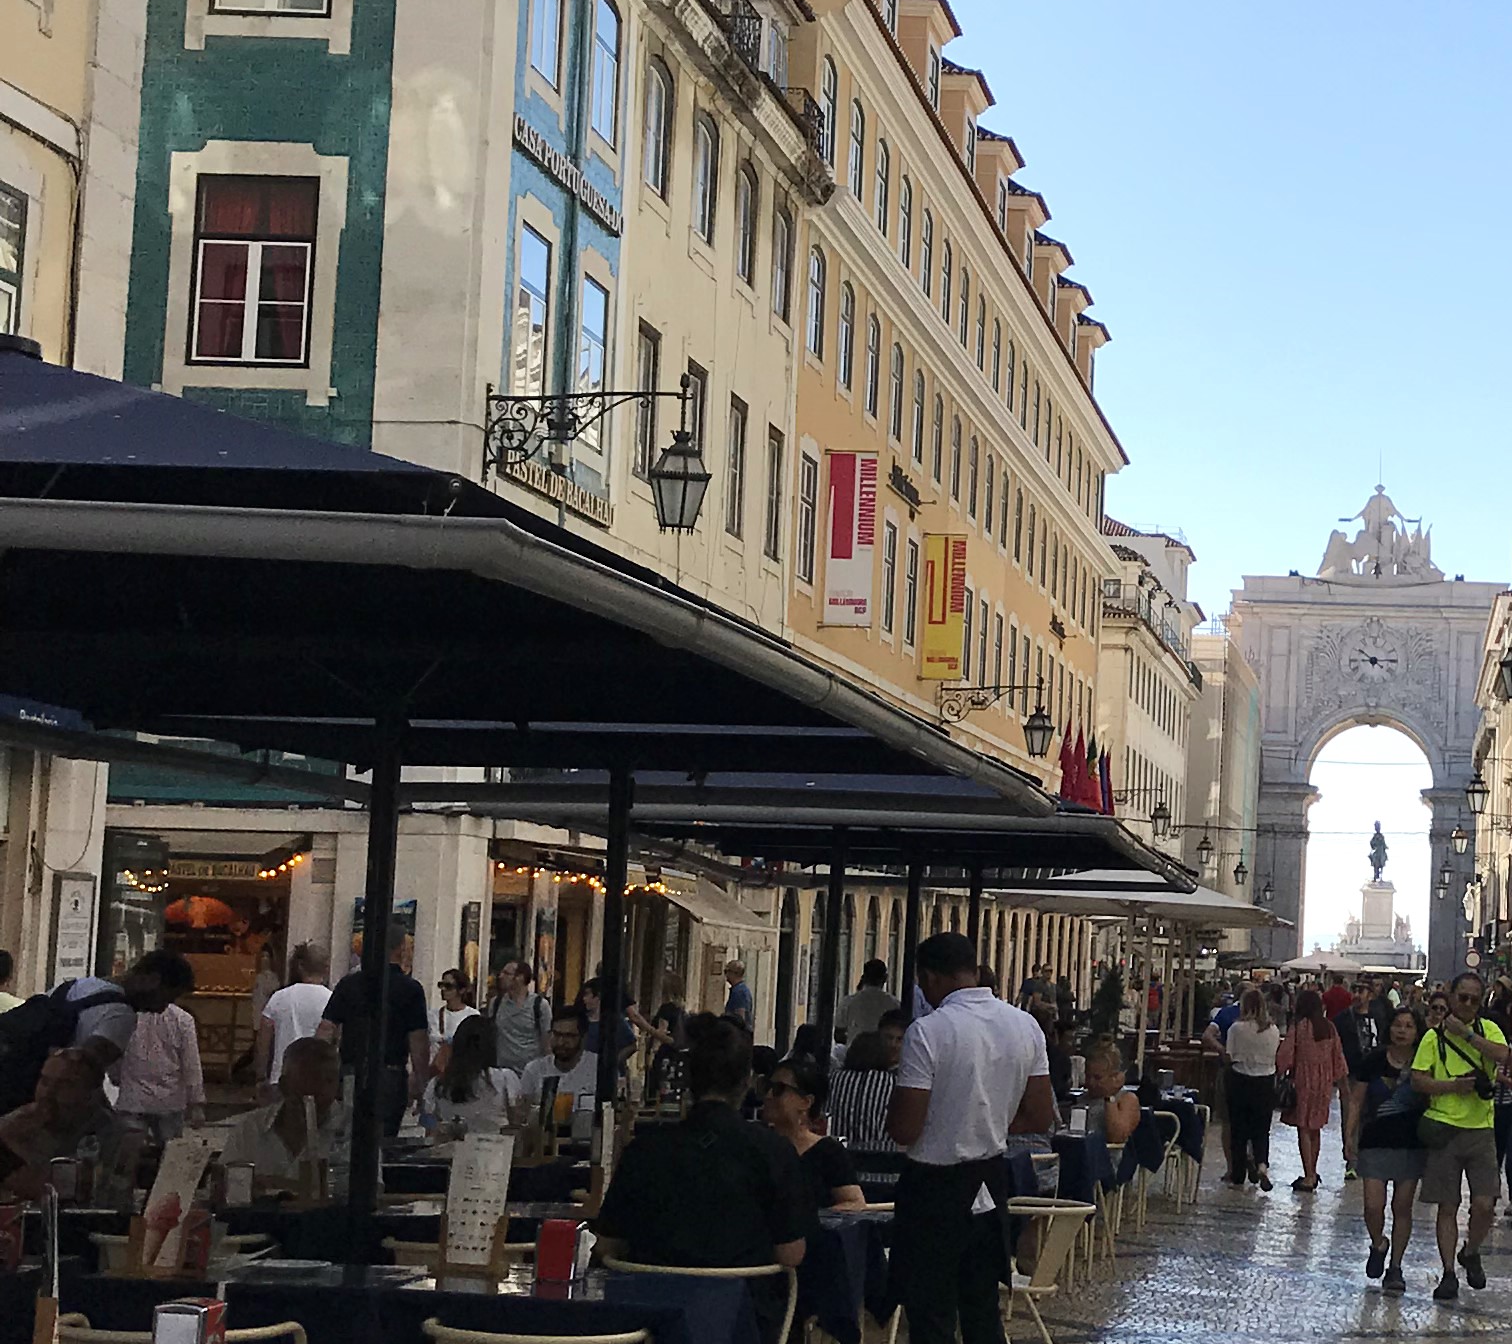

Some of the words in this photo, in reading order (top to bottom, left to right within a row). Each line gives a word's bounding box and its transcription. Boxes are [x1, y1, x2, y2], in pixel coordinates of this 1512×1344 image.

[514, 112, 542, 161] CASA
[549, 472, 566, 502] DE
[566, 480, 614, 526] BACALHAU
[857, 458, 877, 545] MILLENNIUM
[950, 540, 966, 613] MILLENNIUM
